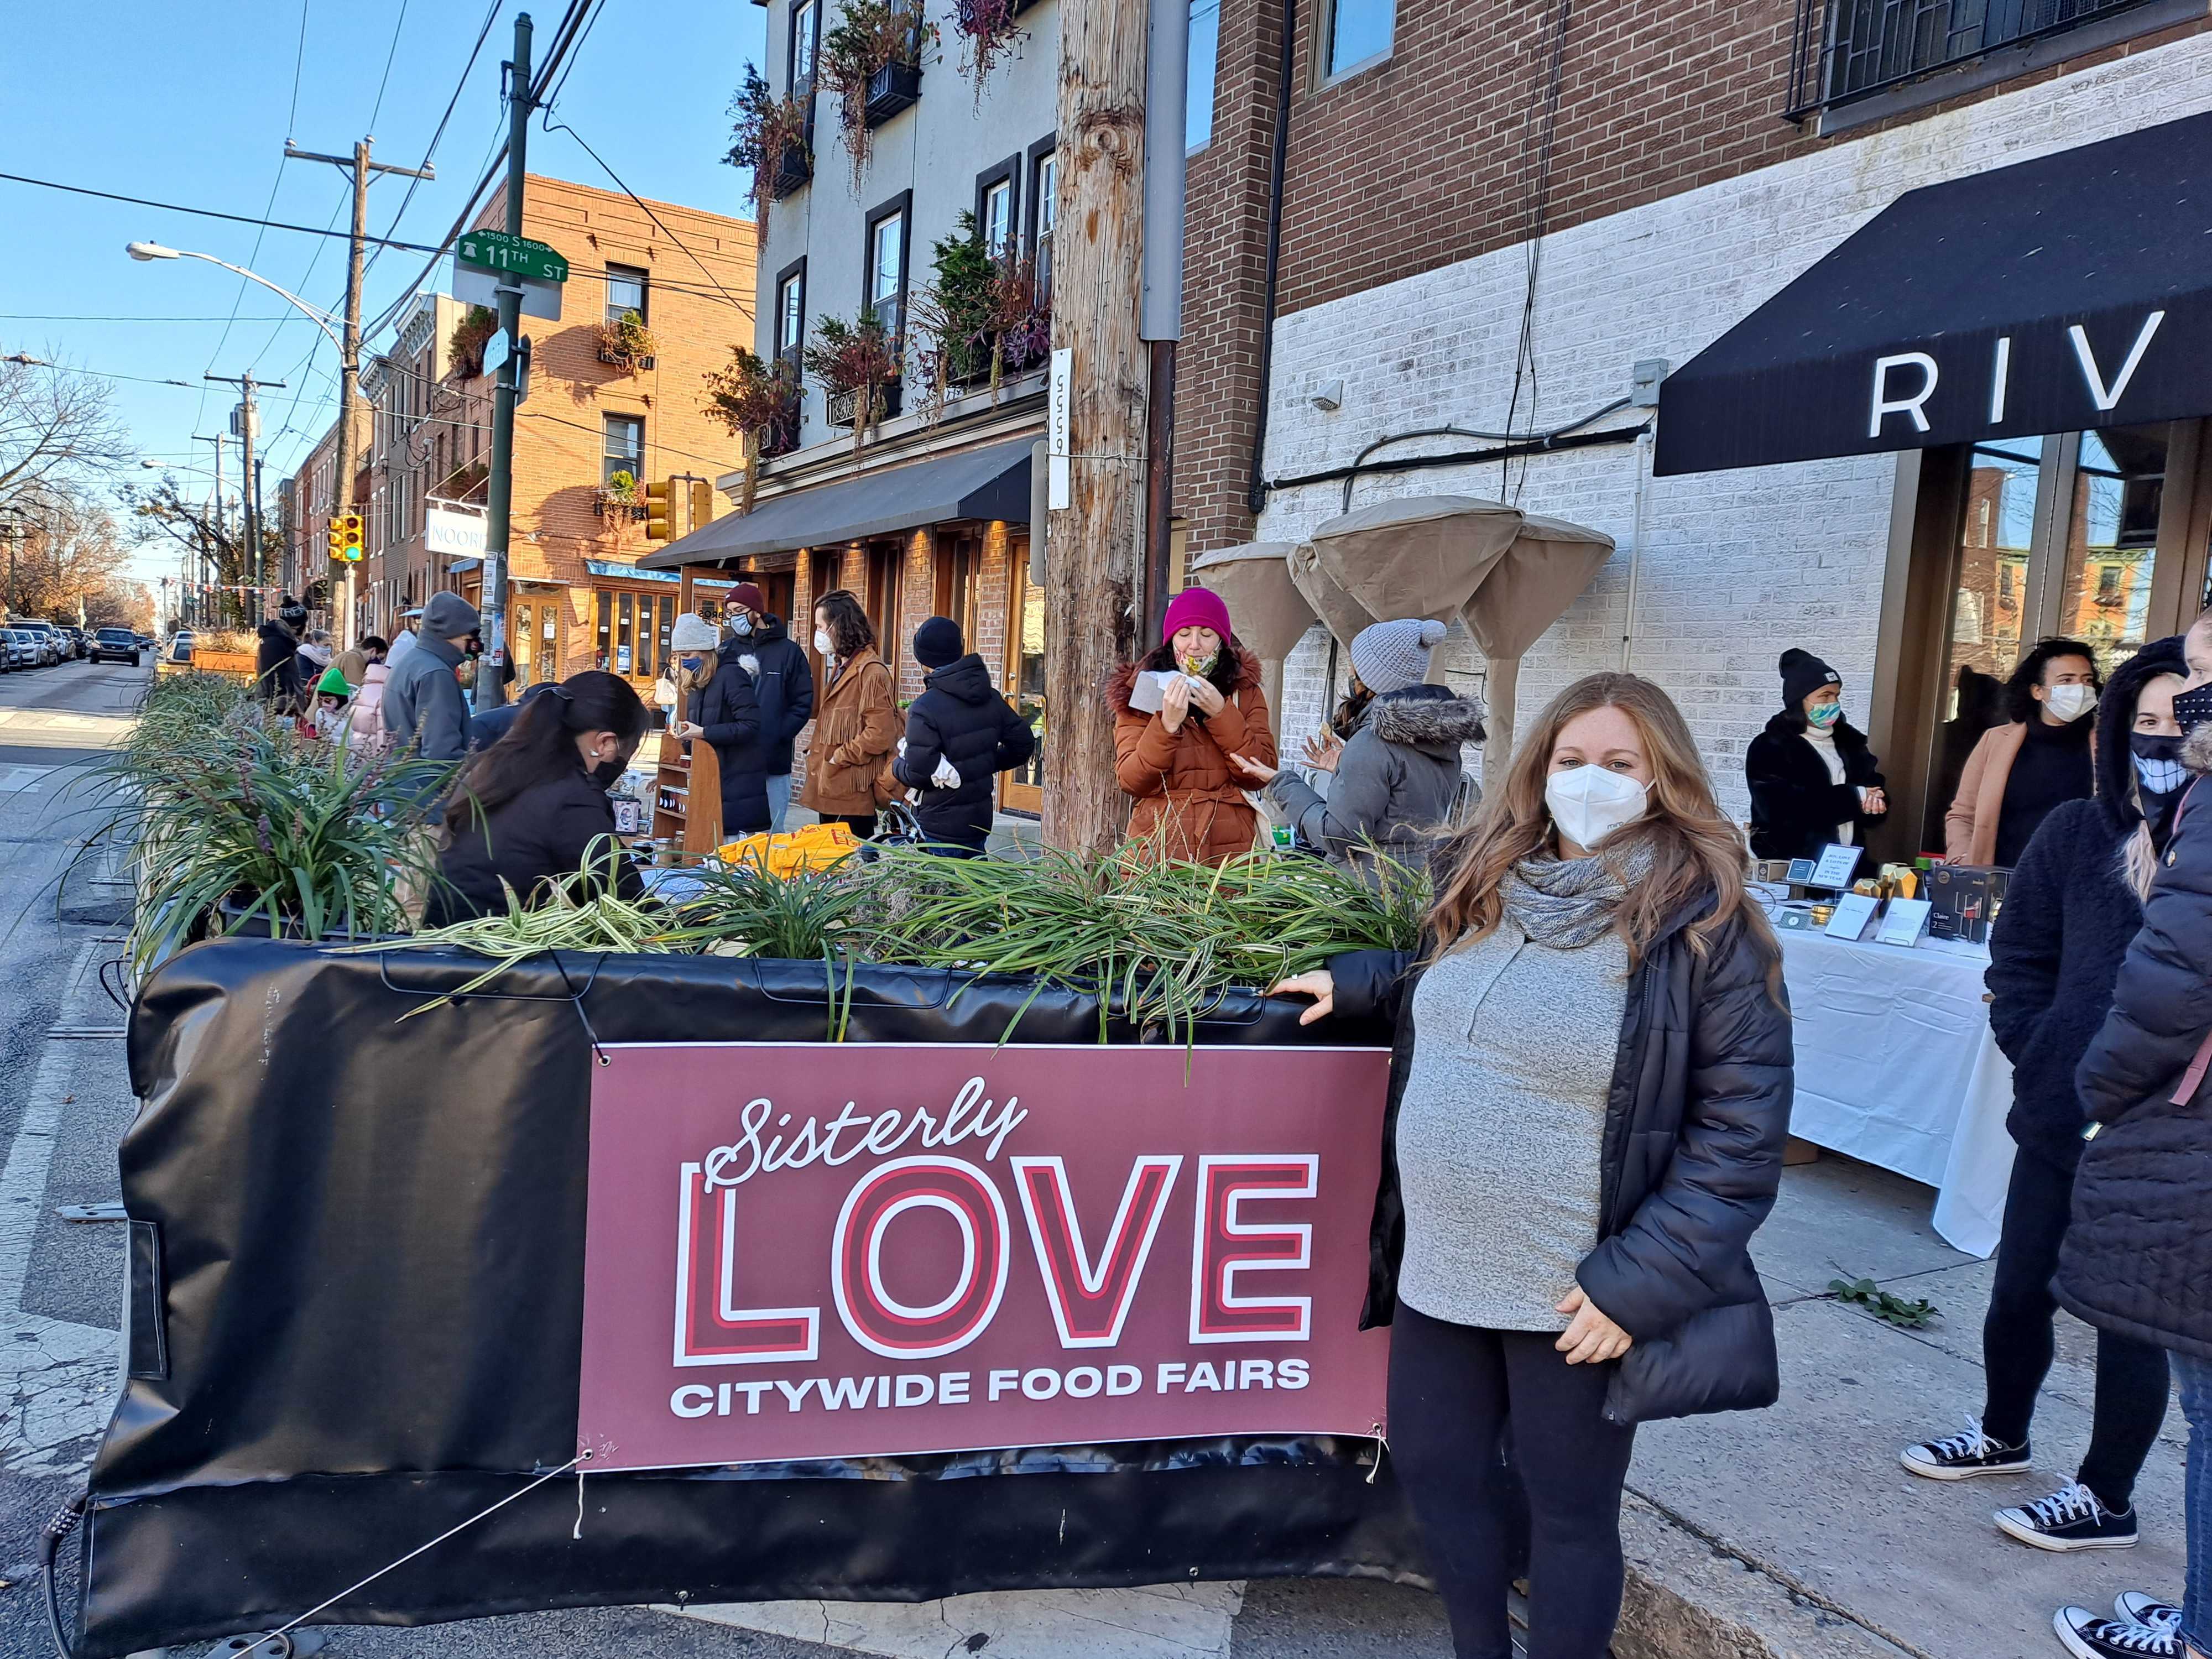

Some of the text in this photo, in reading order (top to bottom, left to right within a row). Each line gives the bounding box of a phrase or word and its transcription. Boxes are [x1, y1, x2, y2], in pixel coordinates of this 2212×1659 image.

[486, 245, 564, 280] 11TH ST
[487, 232, 545, 252] 1500 S 1600
[1868, 310, 2166, 439] RIV
[702, 1075, 1029, 1195] Sisterly
[672, 1152, 1320, 1368] LOVE
[669, 1358, 1311, 1419] CITYWIDE FOOD FAIRS
